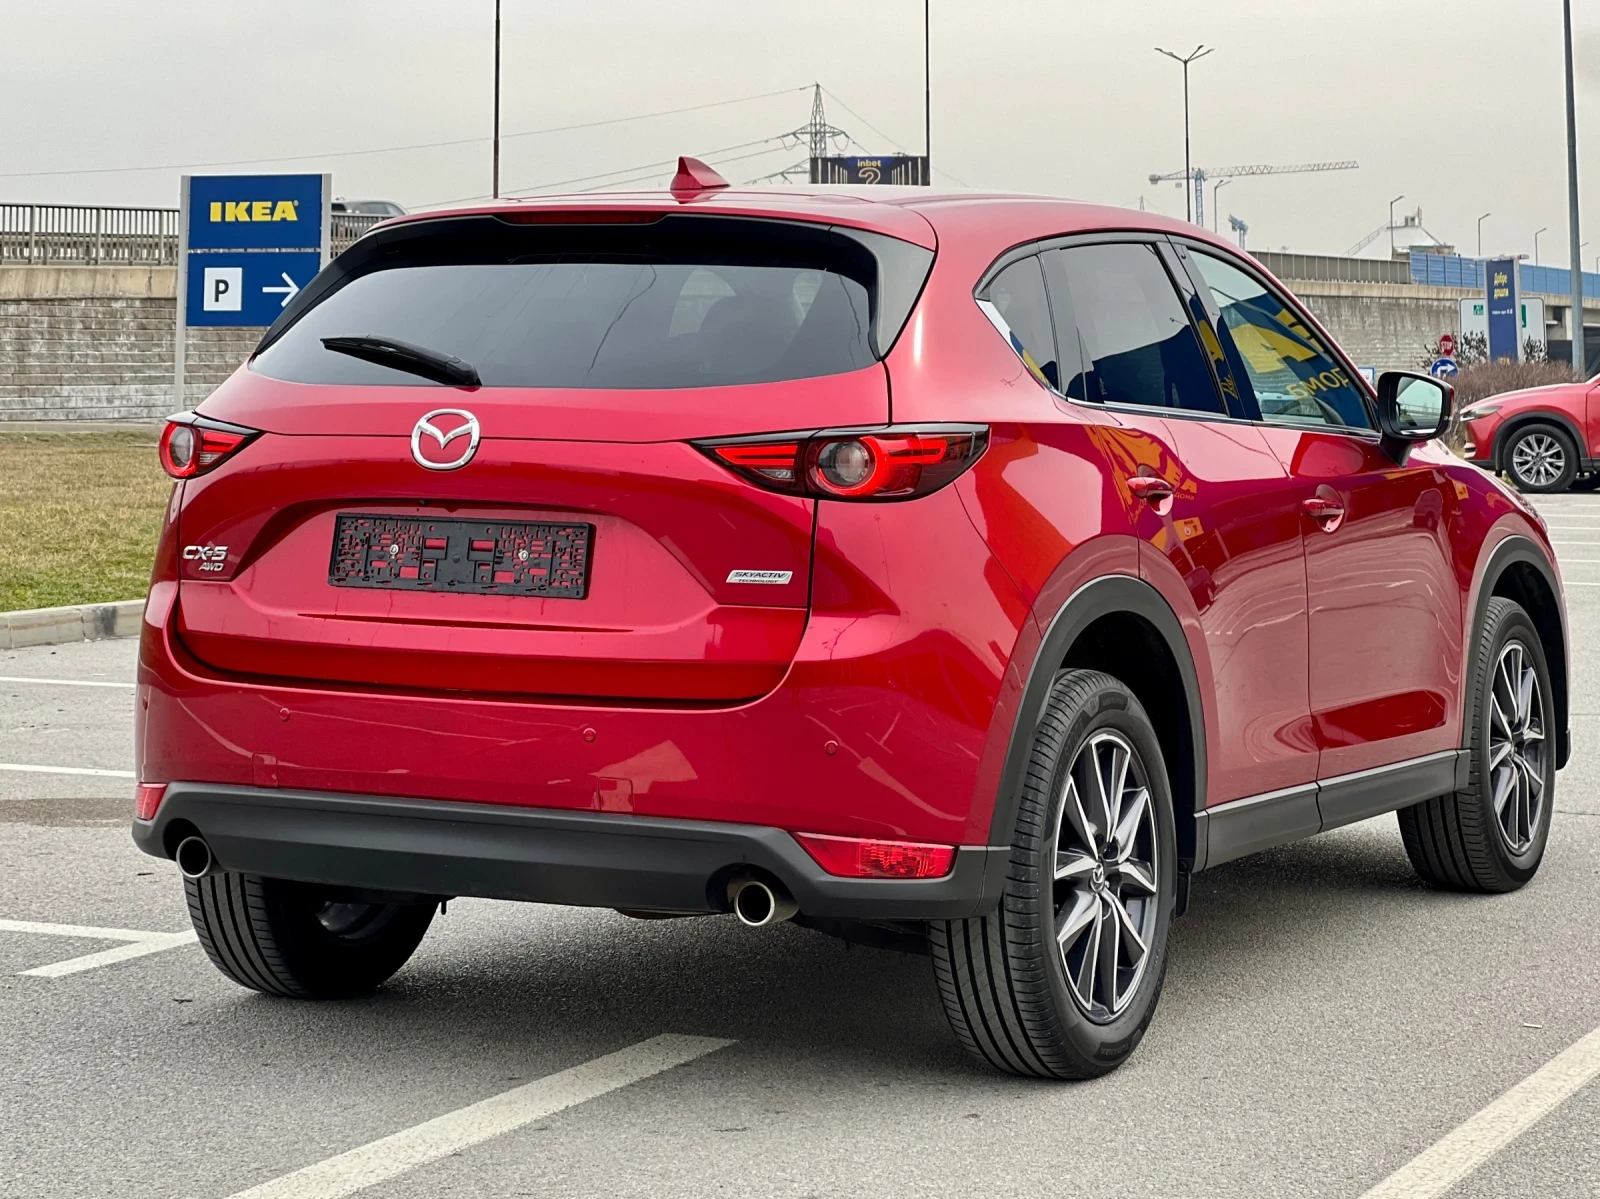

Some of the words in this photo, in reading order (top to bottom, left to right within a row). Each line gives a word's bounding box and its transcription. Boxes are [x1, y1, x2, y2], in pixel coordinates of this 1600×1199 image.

[857, 159, 881, 167] inbet
[210, 201, 298, 222] IKEA
[214, 279, 230, 302] P
[1441, 341, 1453, 352] STOP
[182, 545, 228, 561] CX-5
[199, 562, 224, 572] AWD
